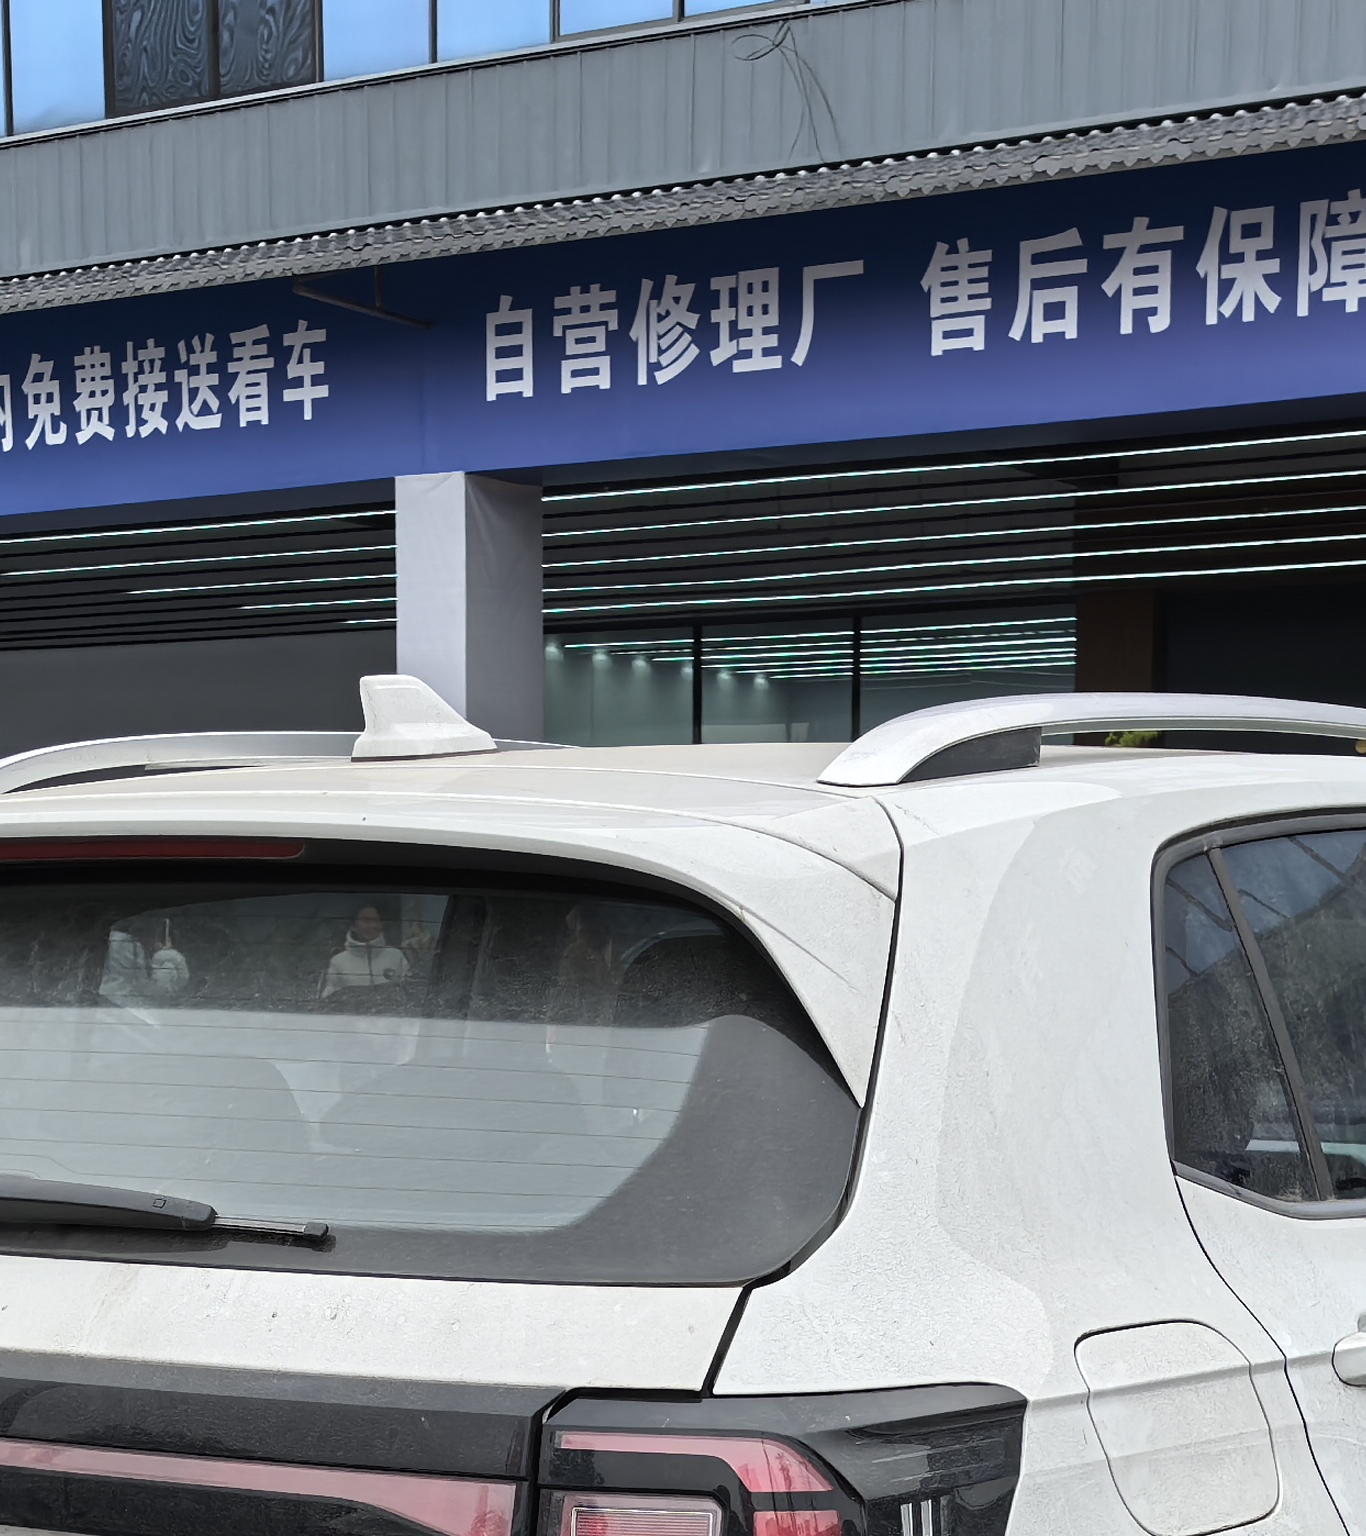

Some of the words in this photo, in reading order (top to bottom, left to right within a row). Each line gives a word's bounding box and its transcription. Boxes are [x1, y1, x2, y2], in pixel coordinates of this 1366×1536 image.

[483, 259, 864, 401] 自营修理厂
